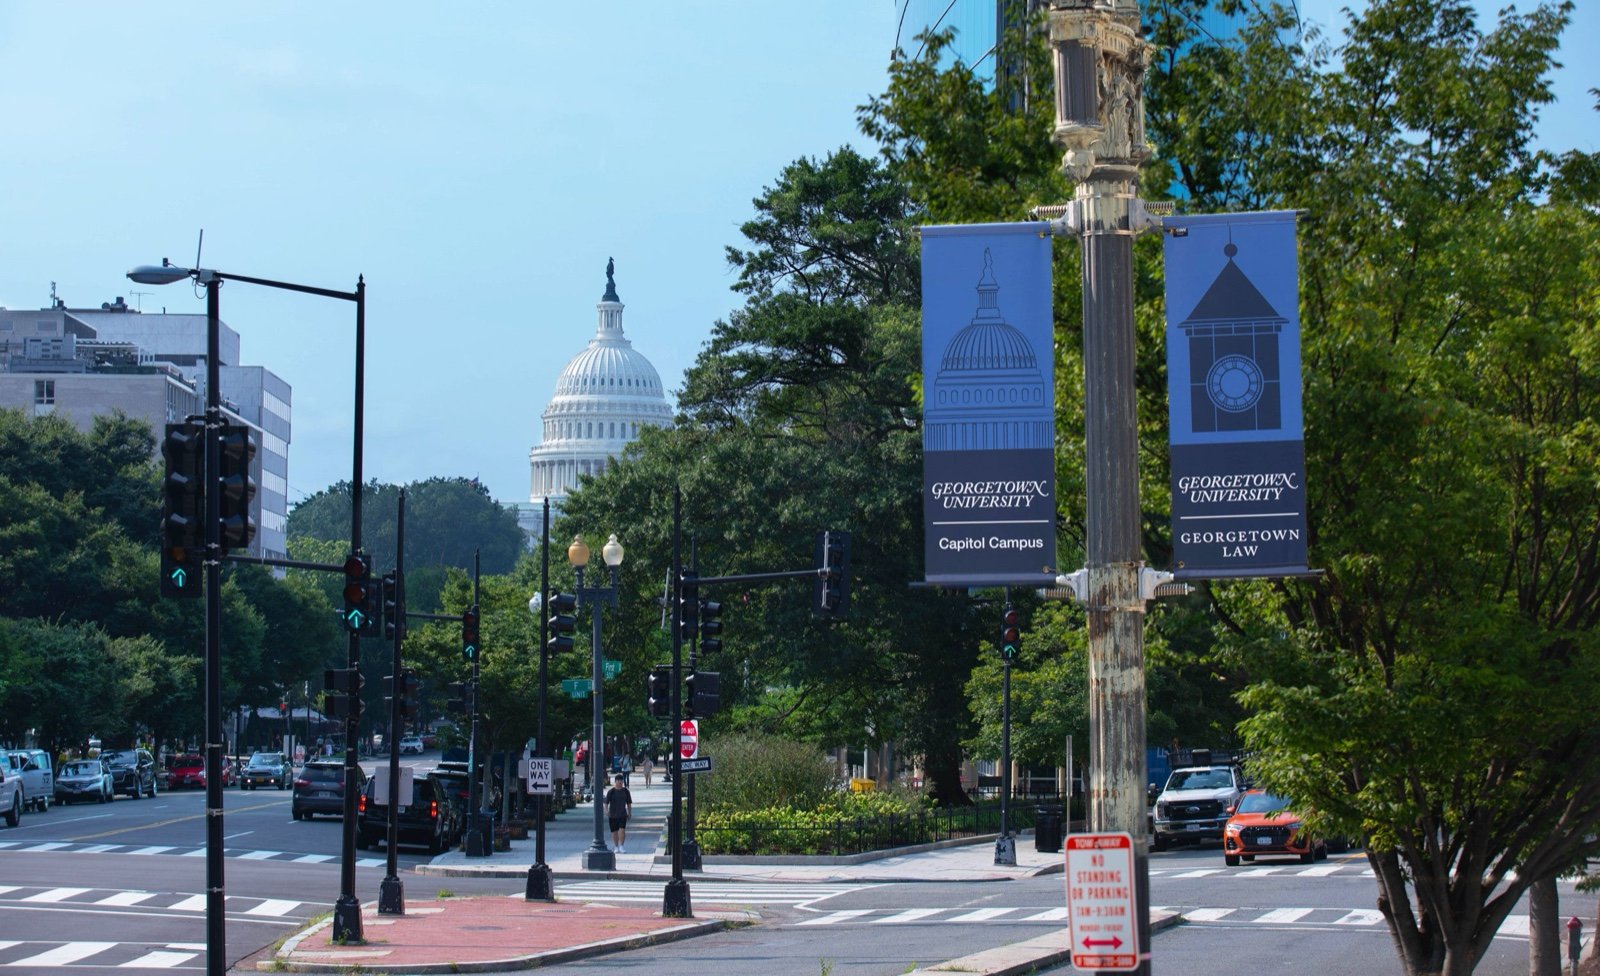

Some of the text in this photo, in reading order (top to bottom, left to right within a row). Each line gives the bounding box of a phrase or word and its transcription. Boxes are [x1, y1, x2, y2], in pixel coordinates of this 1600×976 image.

[931, 480, 1049, 499] GEORGETOWN
[1178, 472, 1299, 494] GEORGETOWN
[943, 495, 1034, 508] UNIVERSITY
[1190, 487, 1284, 503] UNIVERSITY
[1180, 529, 1300, 544] GEORGETOWN
[939, 537, 1044, 552] Capitol Campus
[1222, 546, 1258, 557] LAW
[531, 761, 549, 770] ONE
[530, 771, 550, 780] WAY
[1092, 855, 1104, 867] NO
[1077, 870, 1122, 883] STANDING
[1072, 886, 1129, 899] OR PARKING
